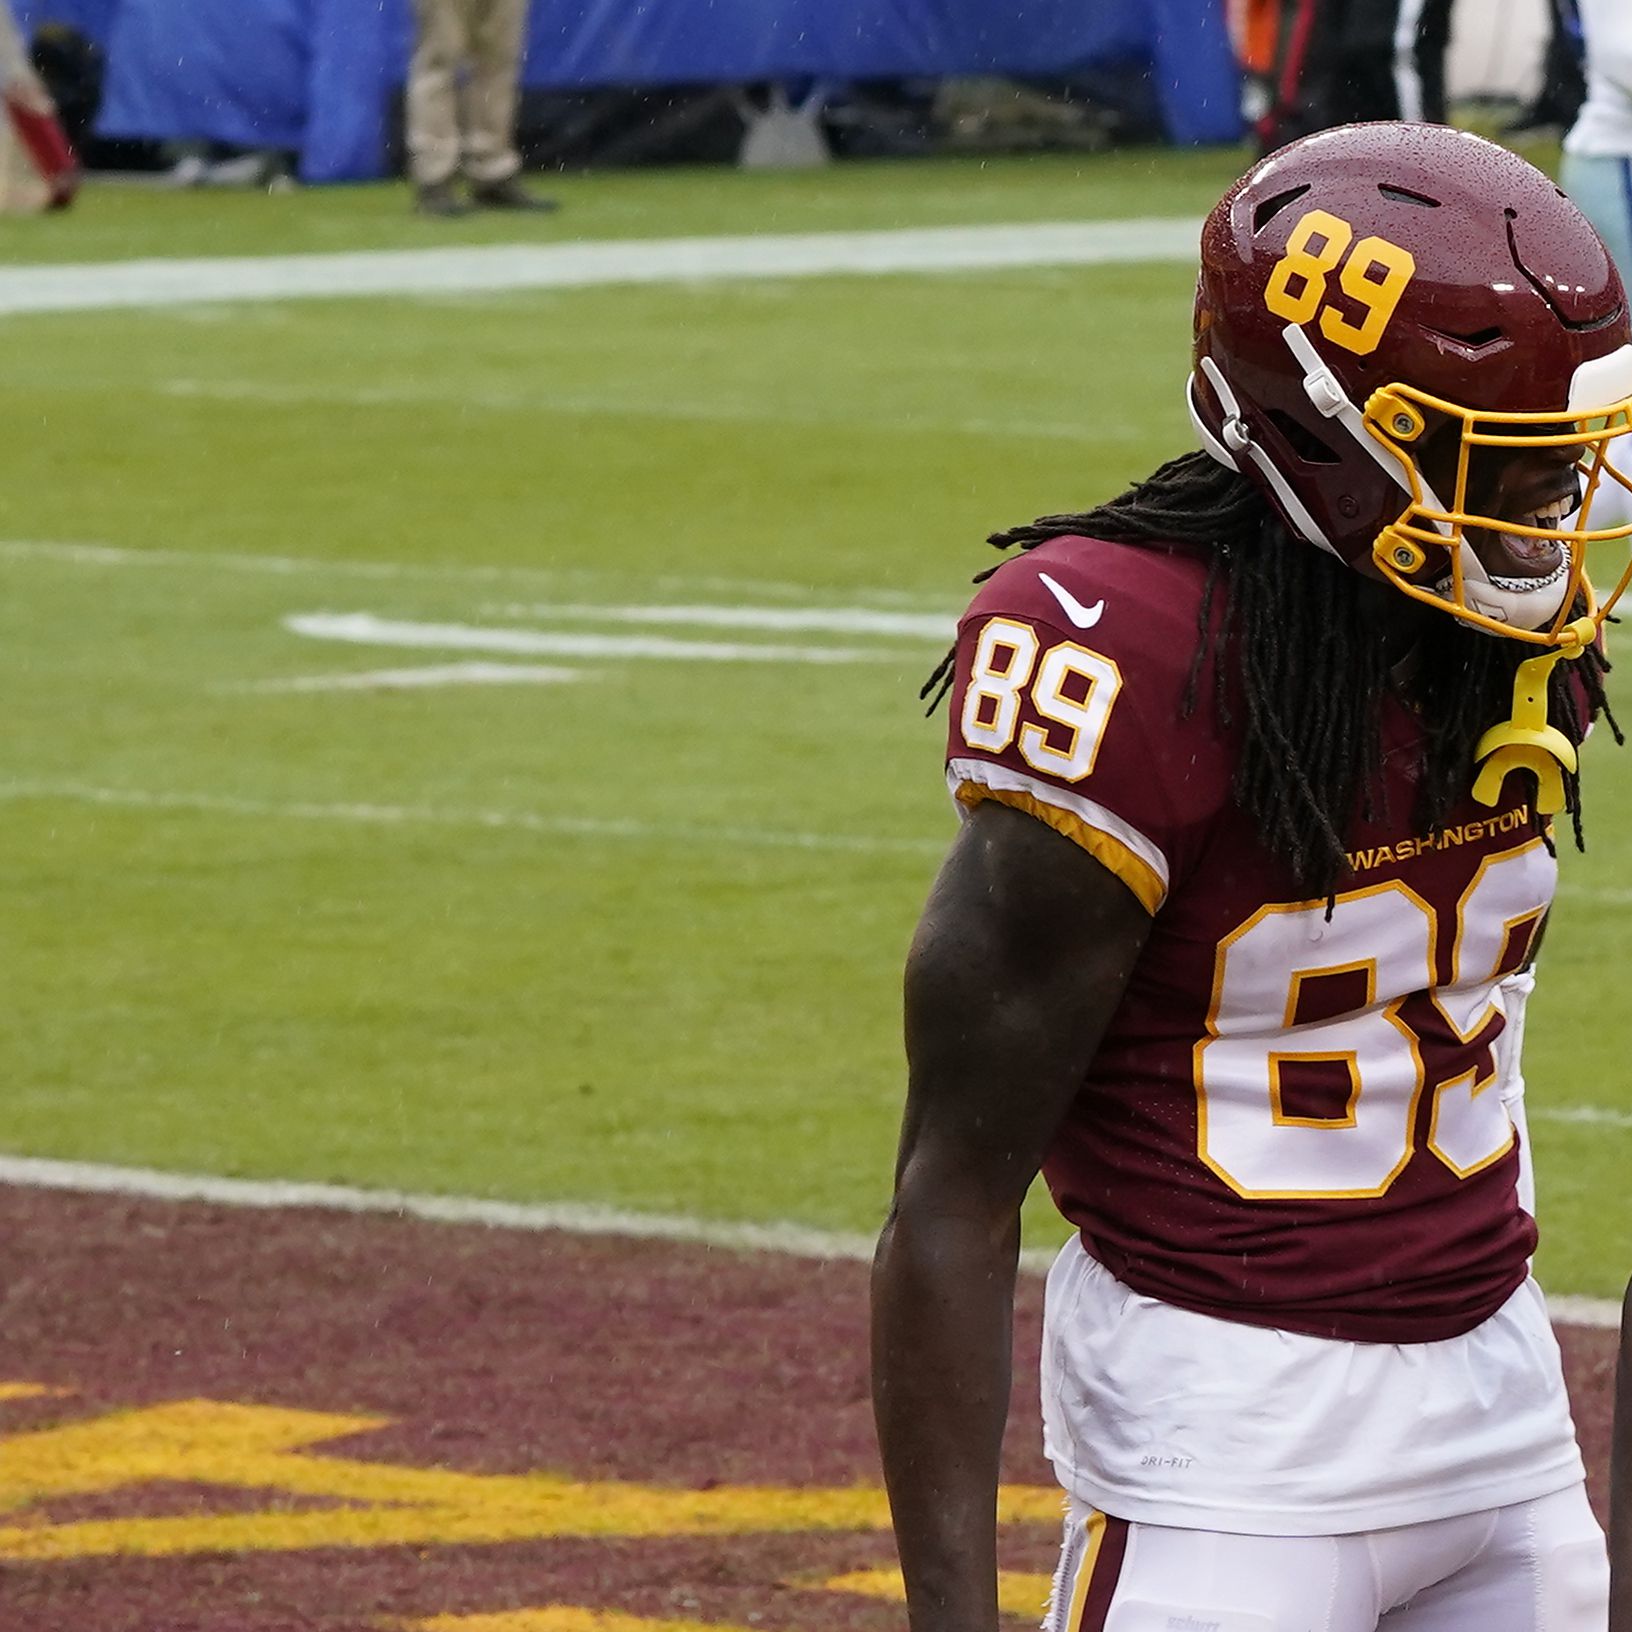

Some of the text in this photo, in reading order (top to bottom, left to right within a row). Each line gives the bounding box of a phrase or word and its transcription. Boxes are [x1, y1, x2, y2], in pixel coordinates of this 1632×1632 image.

[1264, 208, 1415, 356] 89
[959, 616, 1123, 783] 89
[1346, 804, 1529, 873] WASHINGTON
[1193, 835, 1559, 1200] 89
[1140, 1455, 1192, 1469] DRI-FIT
